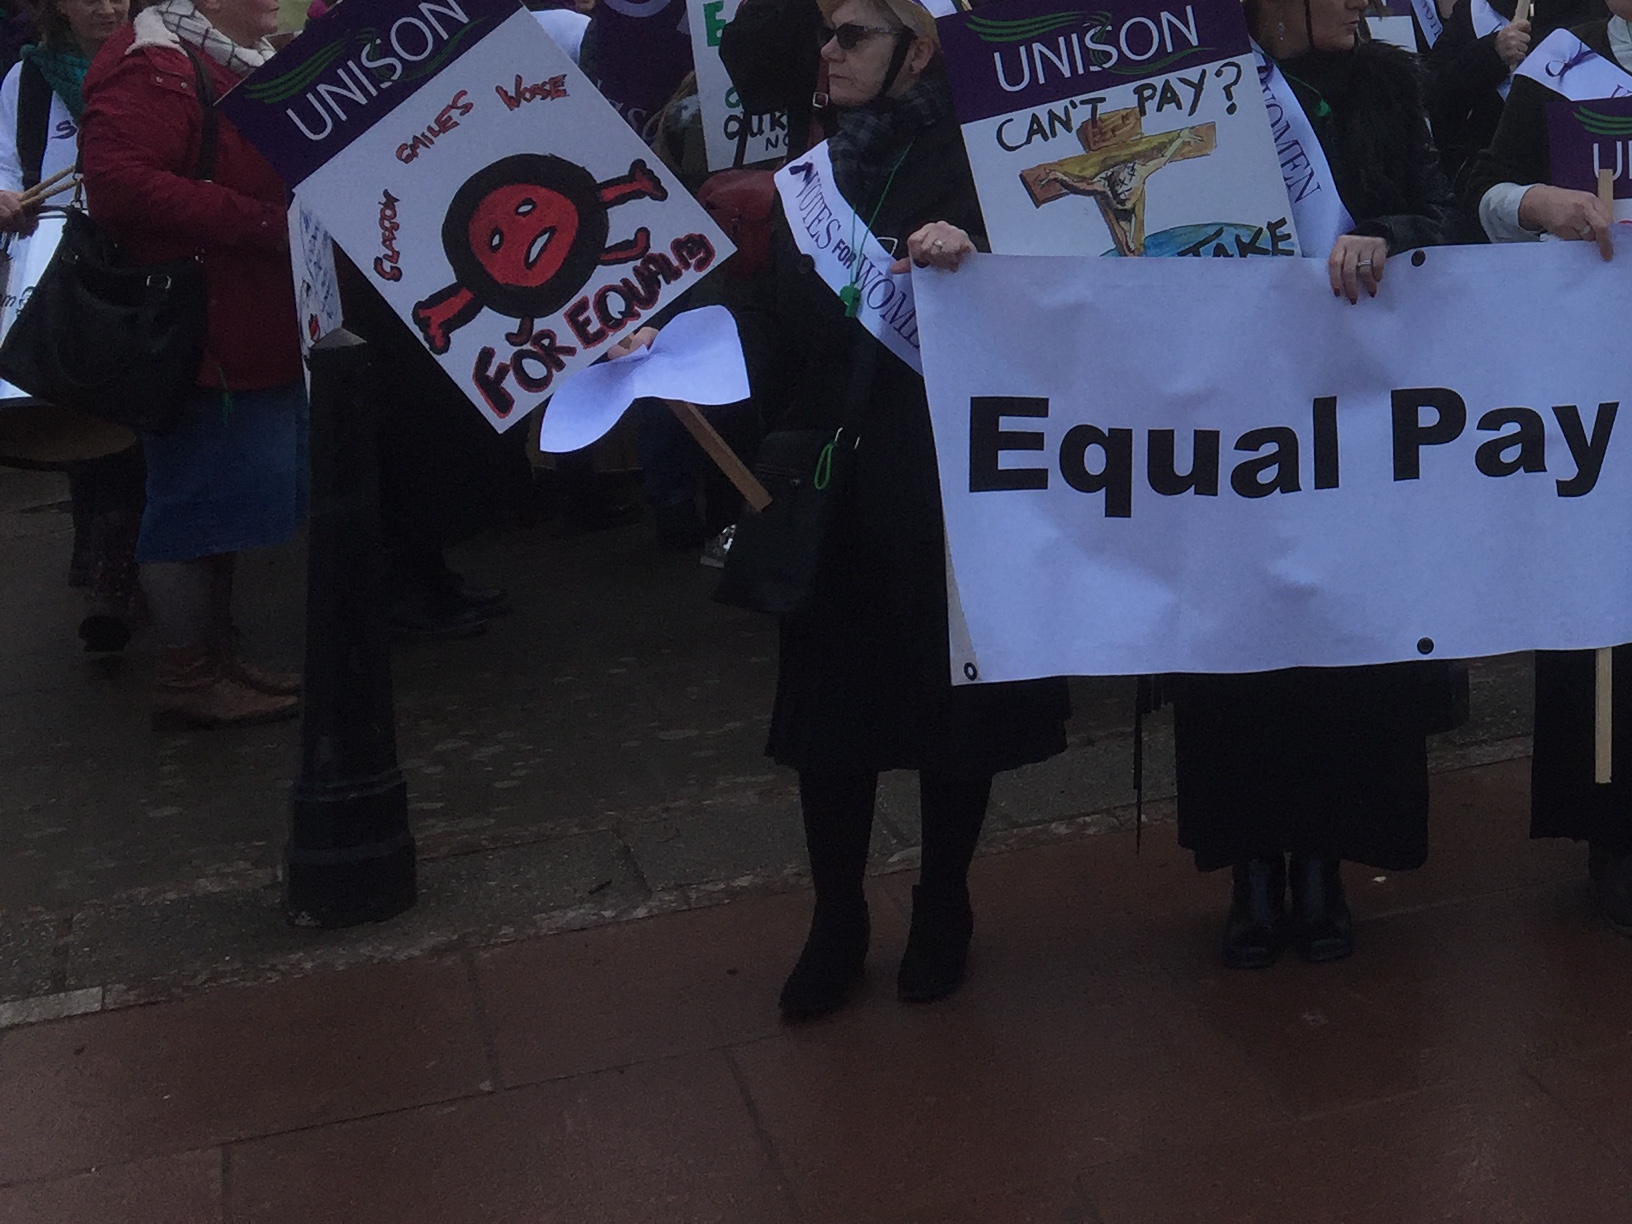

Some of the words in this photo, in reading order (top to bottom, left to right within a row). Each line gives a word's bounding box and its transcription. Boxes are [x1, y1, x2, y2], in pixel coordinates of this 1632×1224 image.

[993, 4, 1200, 93] UNISON
[996, 95, 1106, 153] CAN'T
[1133, 60, 1243, 118] PAY?
[831, 237, 858, 270] FOR
[472, 328, 577, 419] FOR
[968, 394, 1341, 519] Equal
[1390, 385, 1620, 498] Pay
